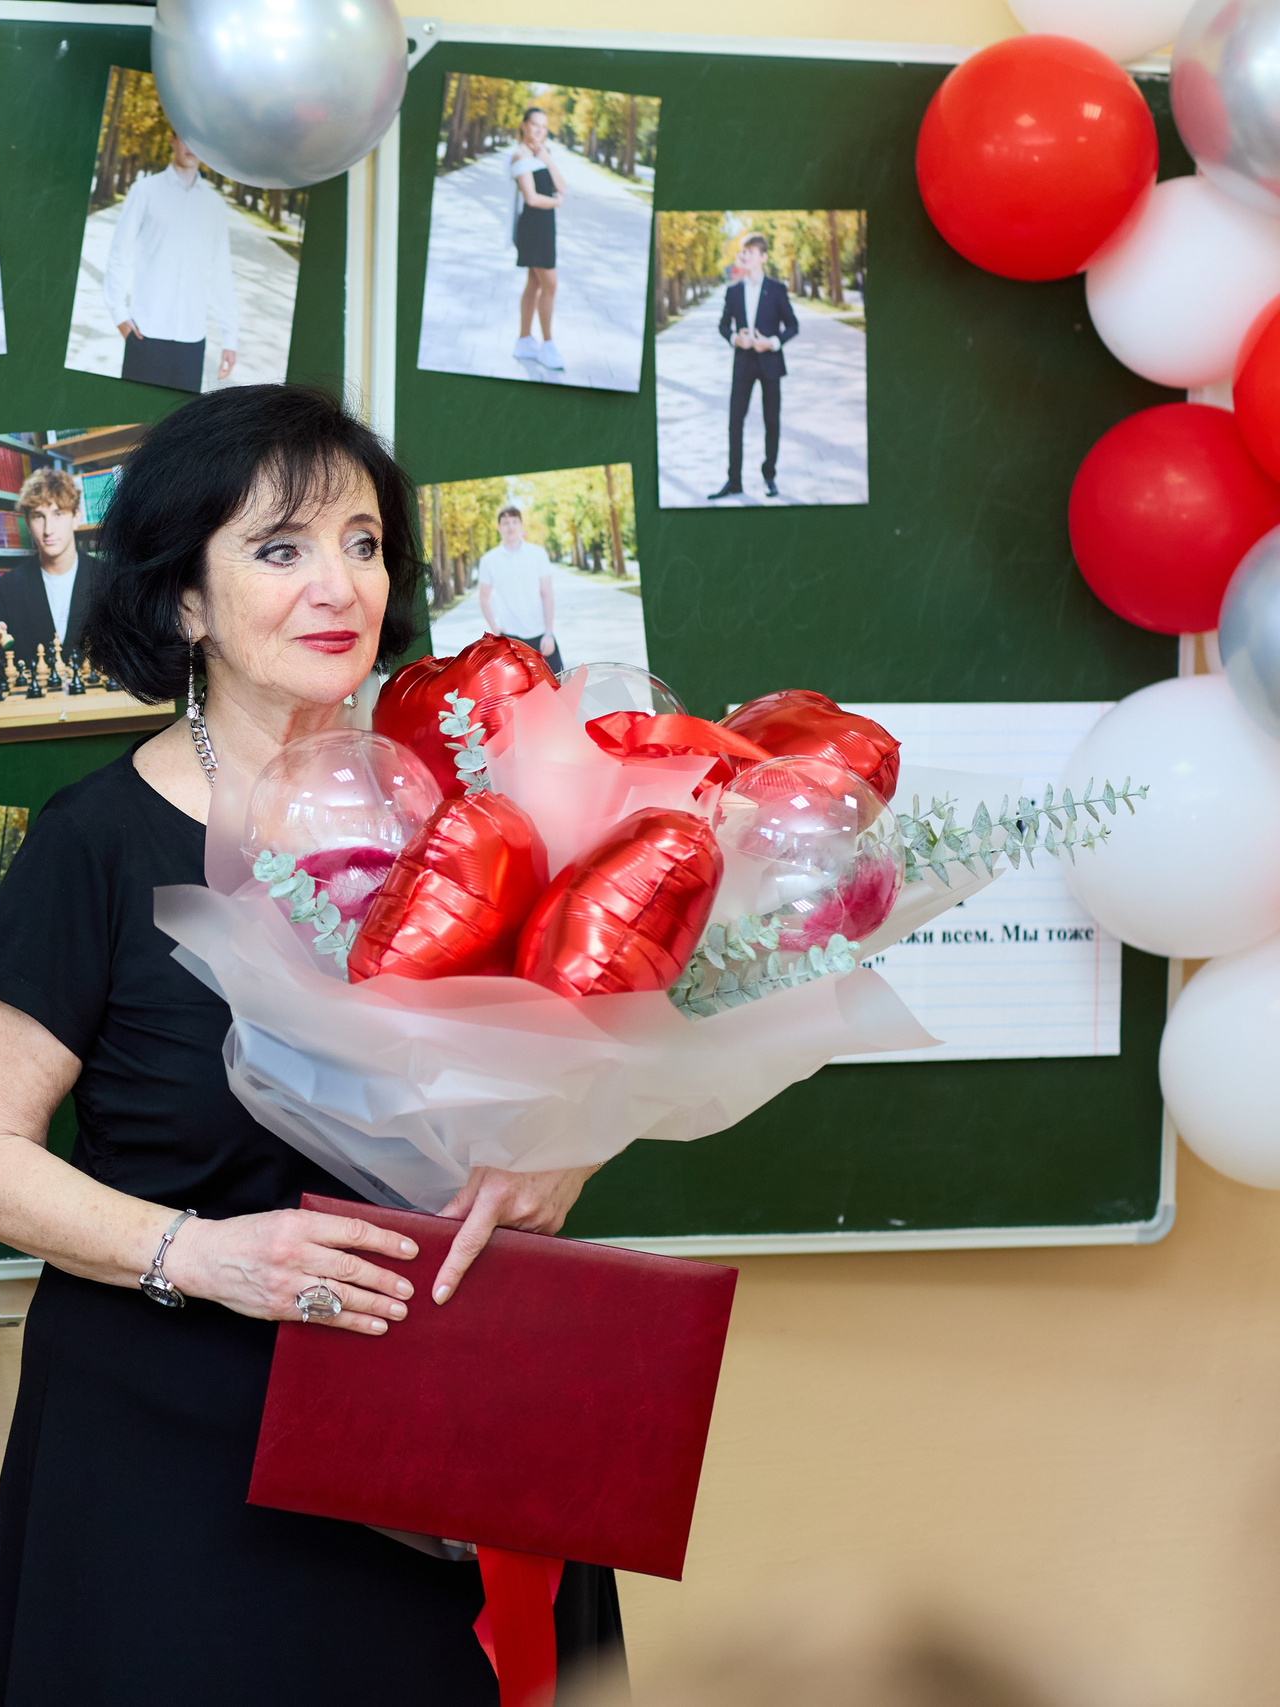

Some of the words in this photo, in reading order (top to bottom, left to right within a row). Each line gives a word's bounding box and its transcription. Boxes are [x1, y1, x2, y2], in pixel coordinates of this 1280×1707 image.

[941, 929, 995, 944] всем.
[1001, 923, 1039, 943] Мы
[1046, 926, 1095, 943] тоже
